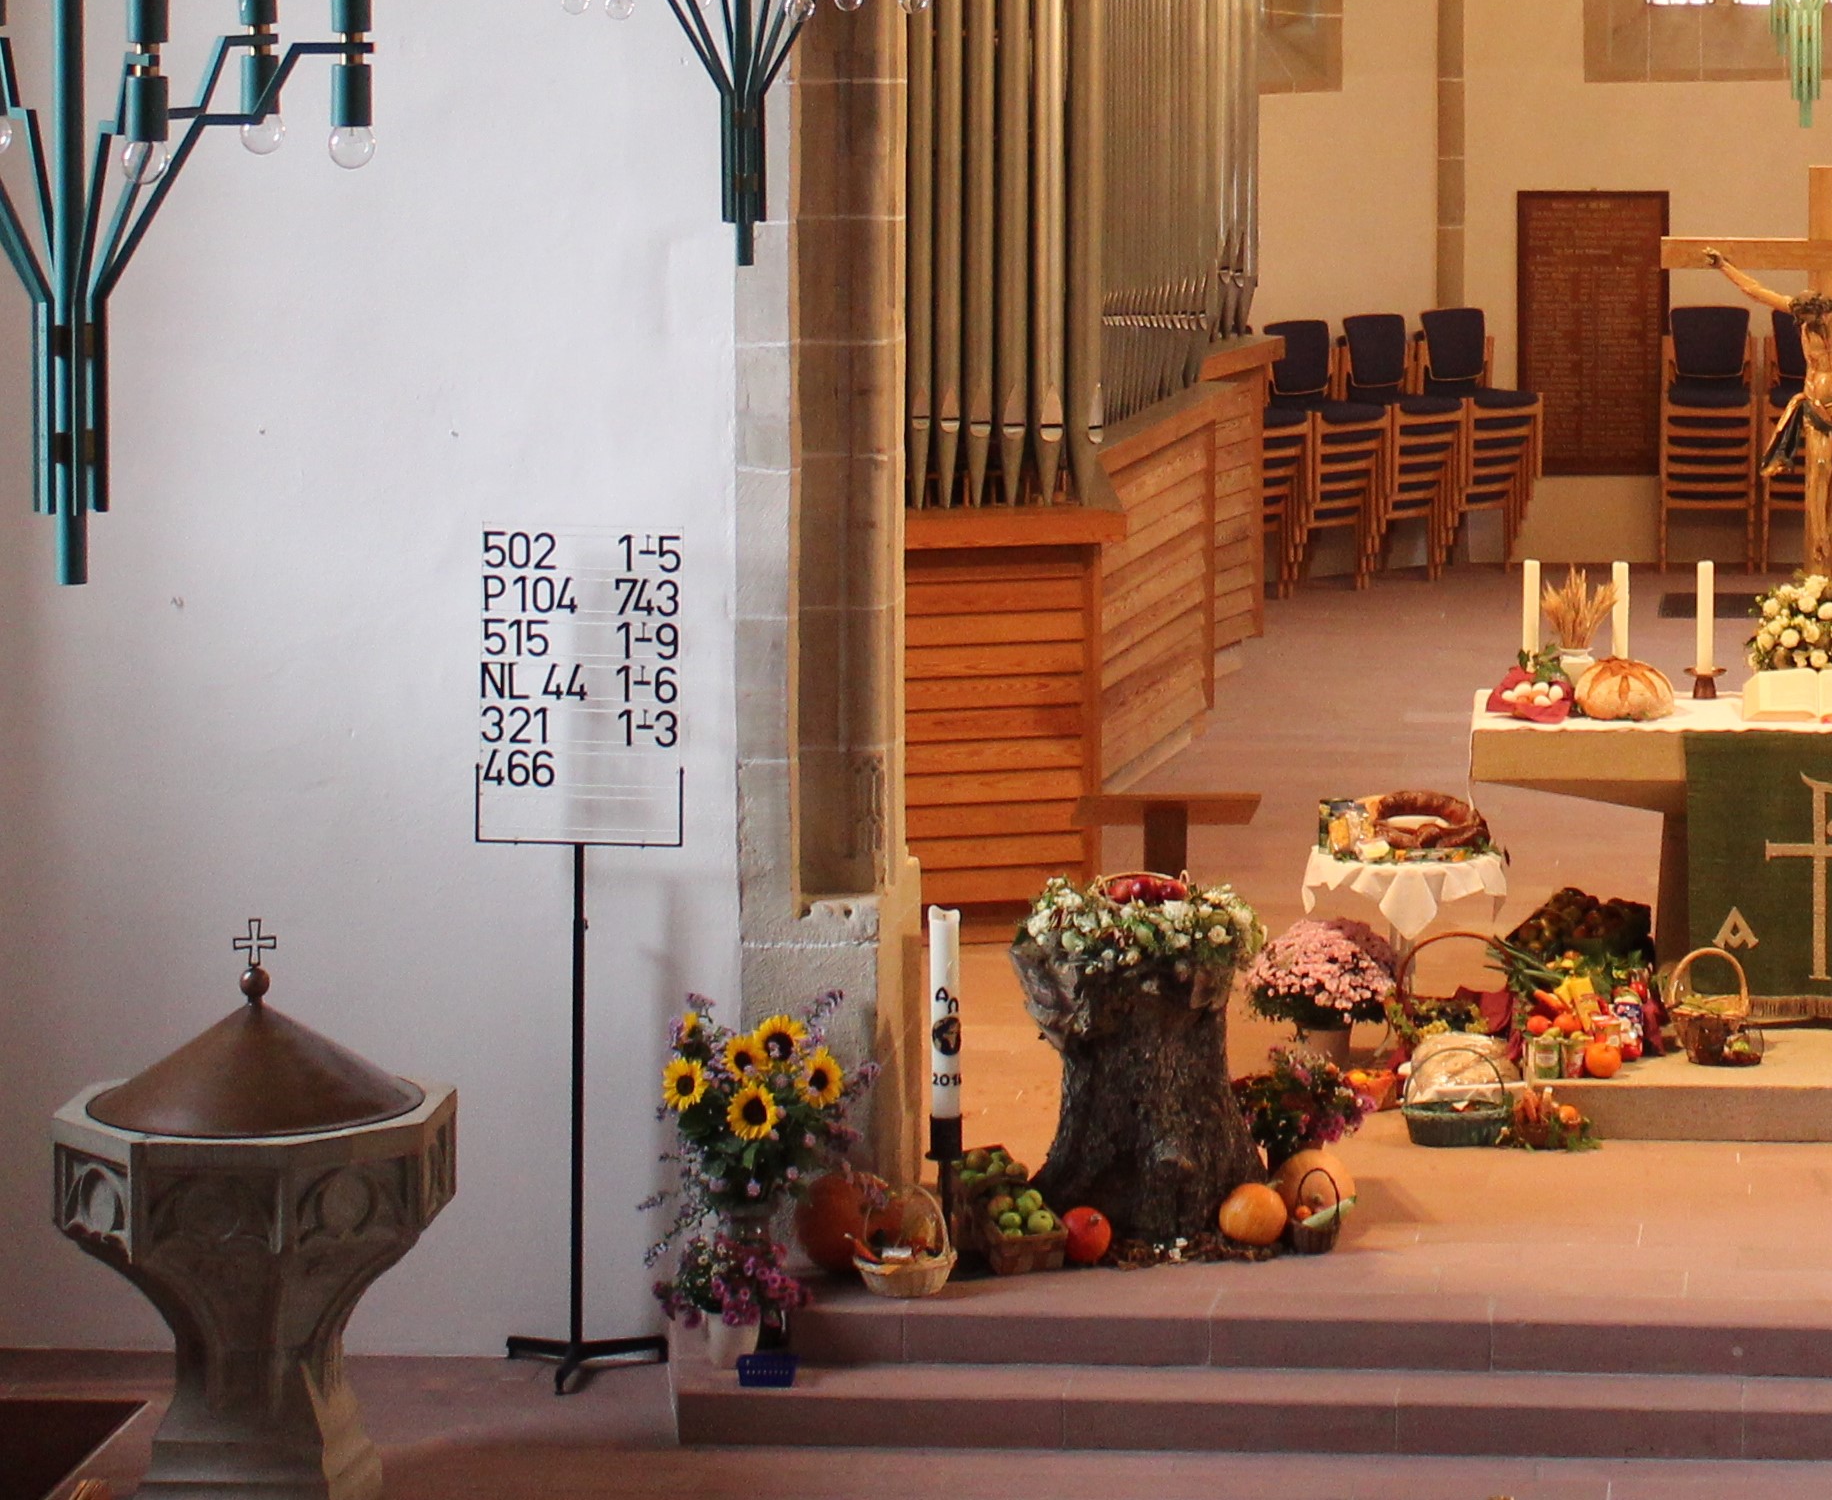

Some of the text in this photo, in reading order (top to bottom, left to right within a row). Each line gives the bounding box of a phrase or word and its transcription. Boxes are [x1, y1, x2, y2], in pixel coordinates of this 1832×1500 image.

[483, 531, 681, 573] 502 1-5
[614, 578, 679, 617] 743
[483, 618, 679, 661] 515 1-9
[480, 661, 678, 704] NL 44 1-6
[481, 705, 678, 748] 321 1-3
[482, 748, 556, 788] 466
